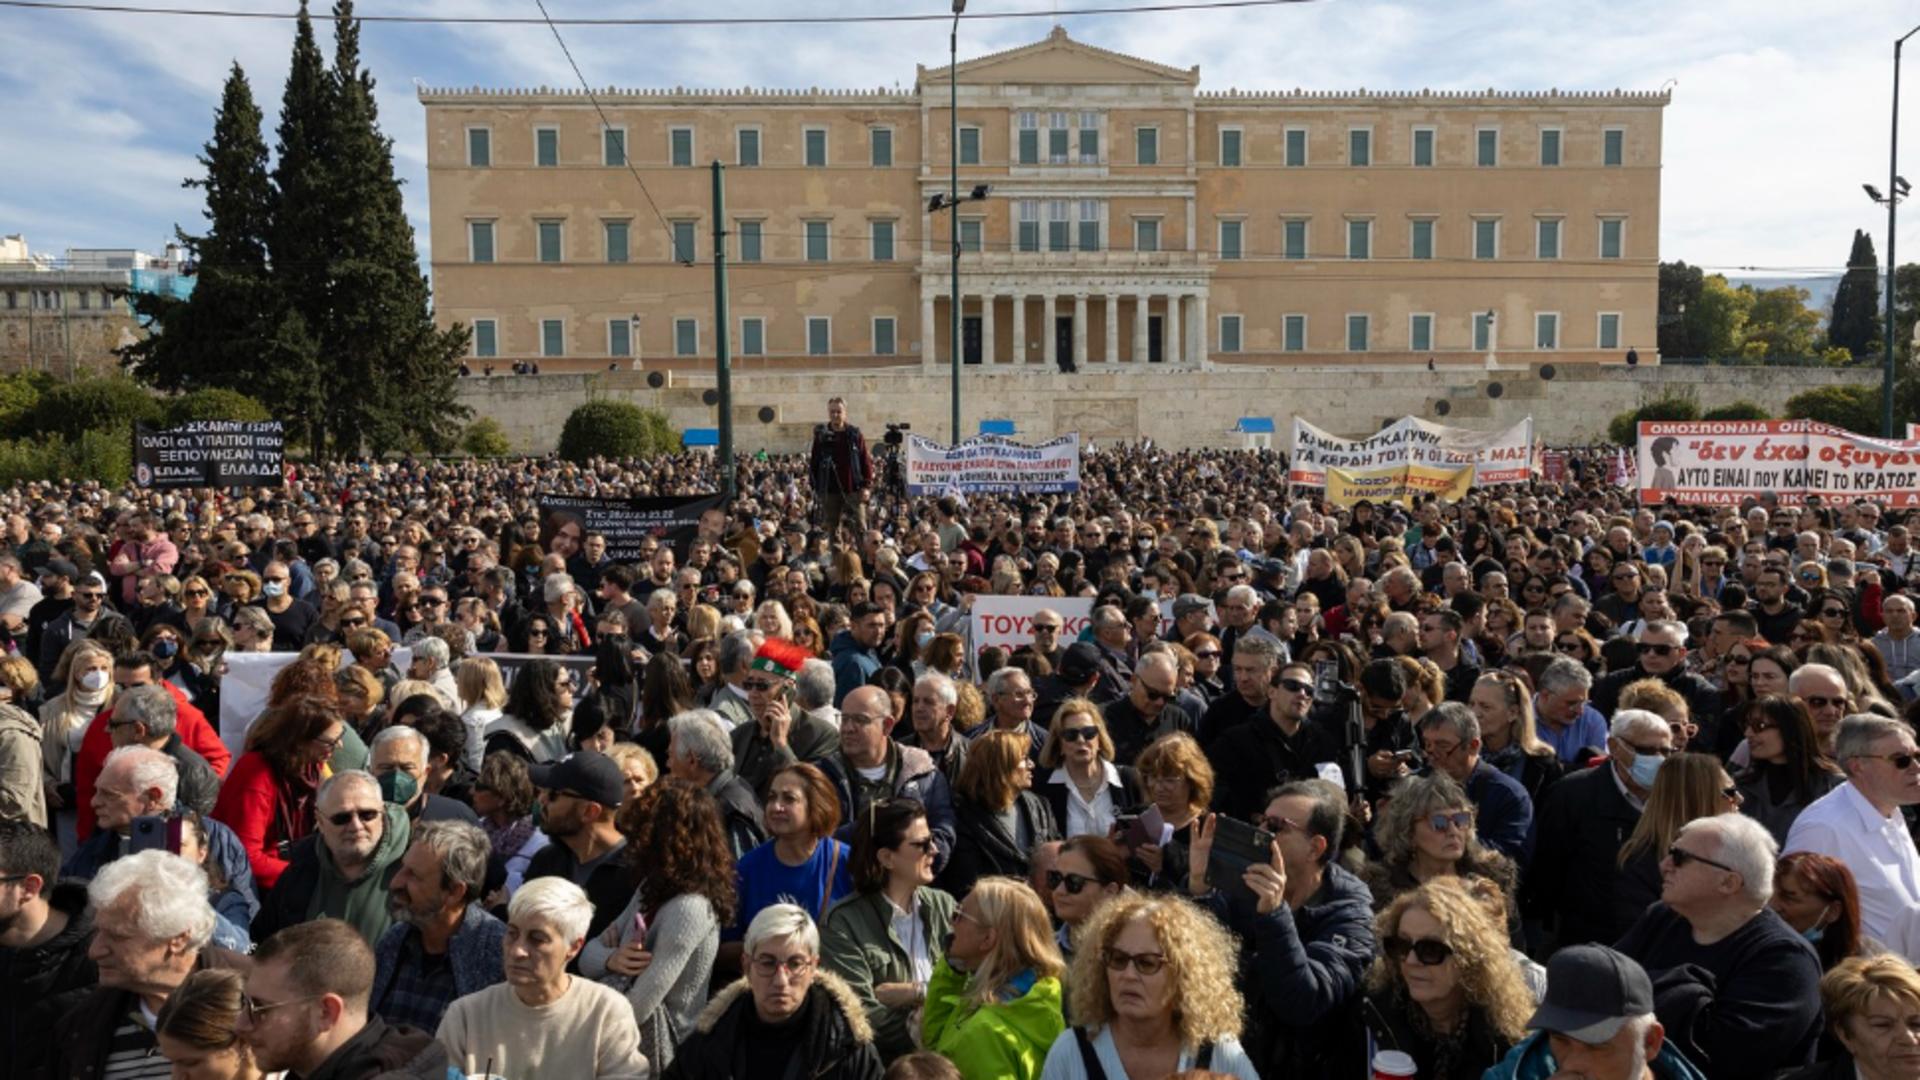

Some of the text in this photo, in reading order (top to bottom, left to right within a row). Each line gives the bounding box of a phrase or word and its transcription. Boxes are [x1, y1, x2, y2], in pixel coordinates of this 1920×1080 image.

[1650, 423, 1768, 434] ΟΜΟΣΠΟΝΔΙΑ
[177, 437, 191, 447] οι
[195, 434, 253, 447] ΥΠΑΙΤΙΟΙ
[256, 436, 283, 446] που
[158, 449, 282, 463] ΞΕΠΟΥΛΗΣΑΝ την
[1296, 449, 1315, 462] ΤΑ
[1319, 453, 1373, 467] ΚΕΡΔΗ
[1490, 446, 1527, 461] ΜΑΣ
[1753, 438, 1809, 461] έχω
[220, 464, 281, 475] ΕΛΛΑΔΑ
[1678, 468, 1709, 486] ΑΥΤΟ
[1713, 468, 1750, 487] ΕΙΝΑΙ
[1783, 469, 1828, 489] ΚΑΝΕΙ
[1854, 472, 1917, 489] ΚΡΑΤΟΣ
